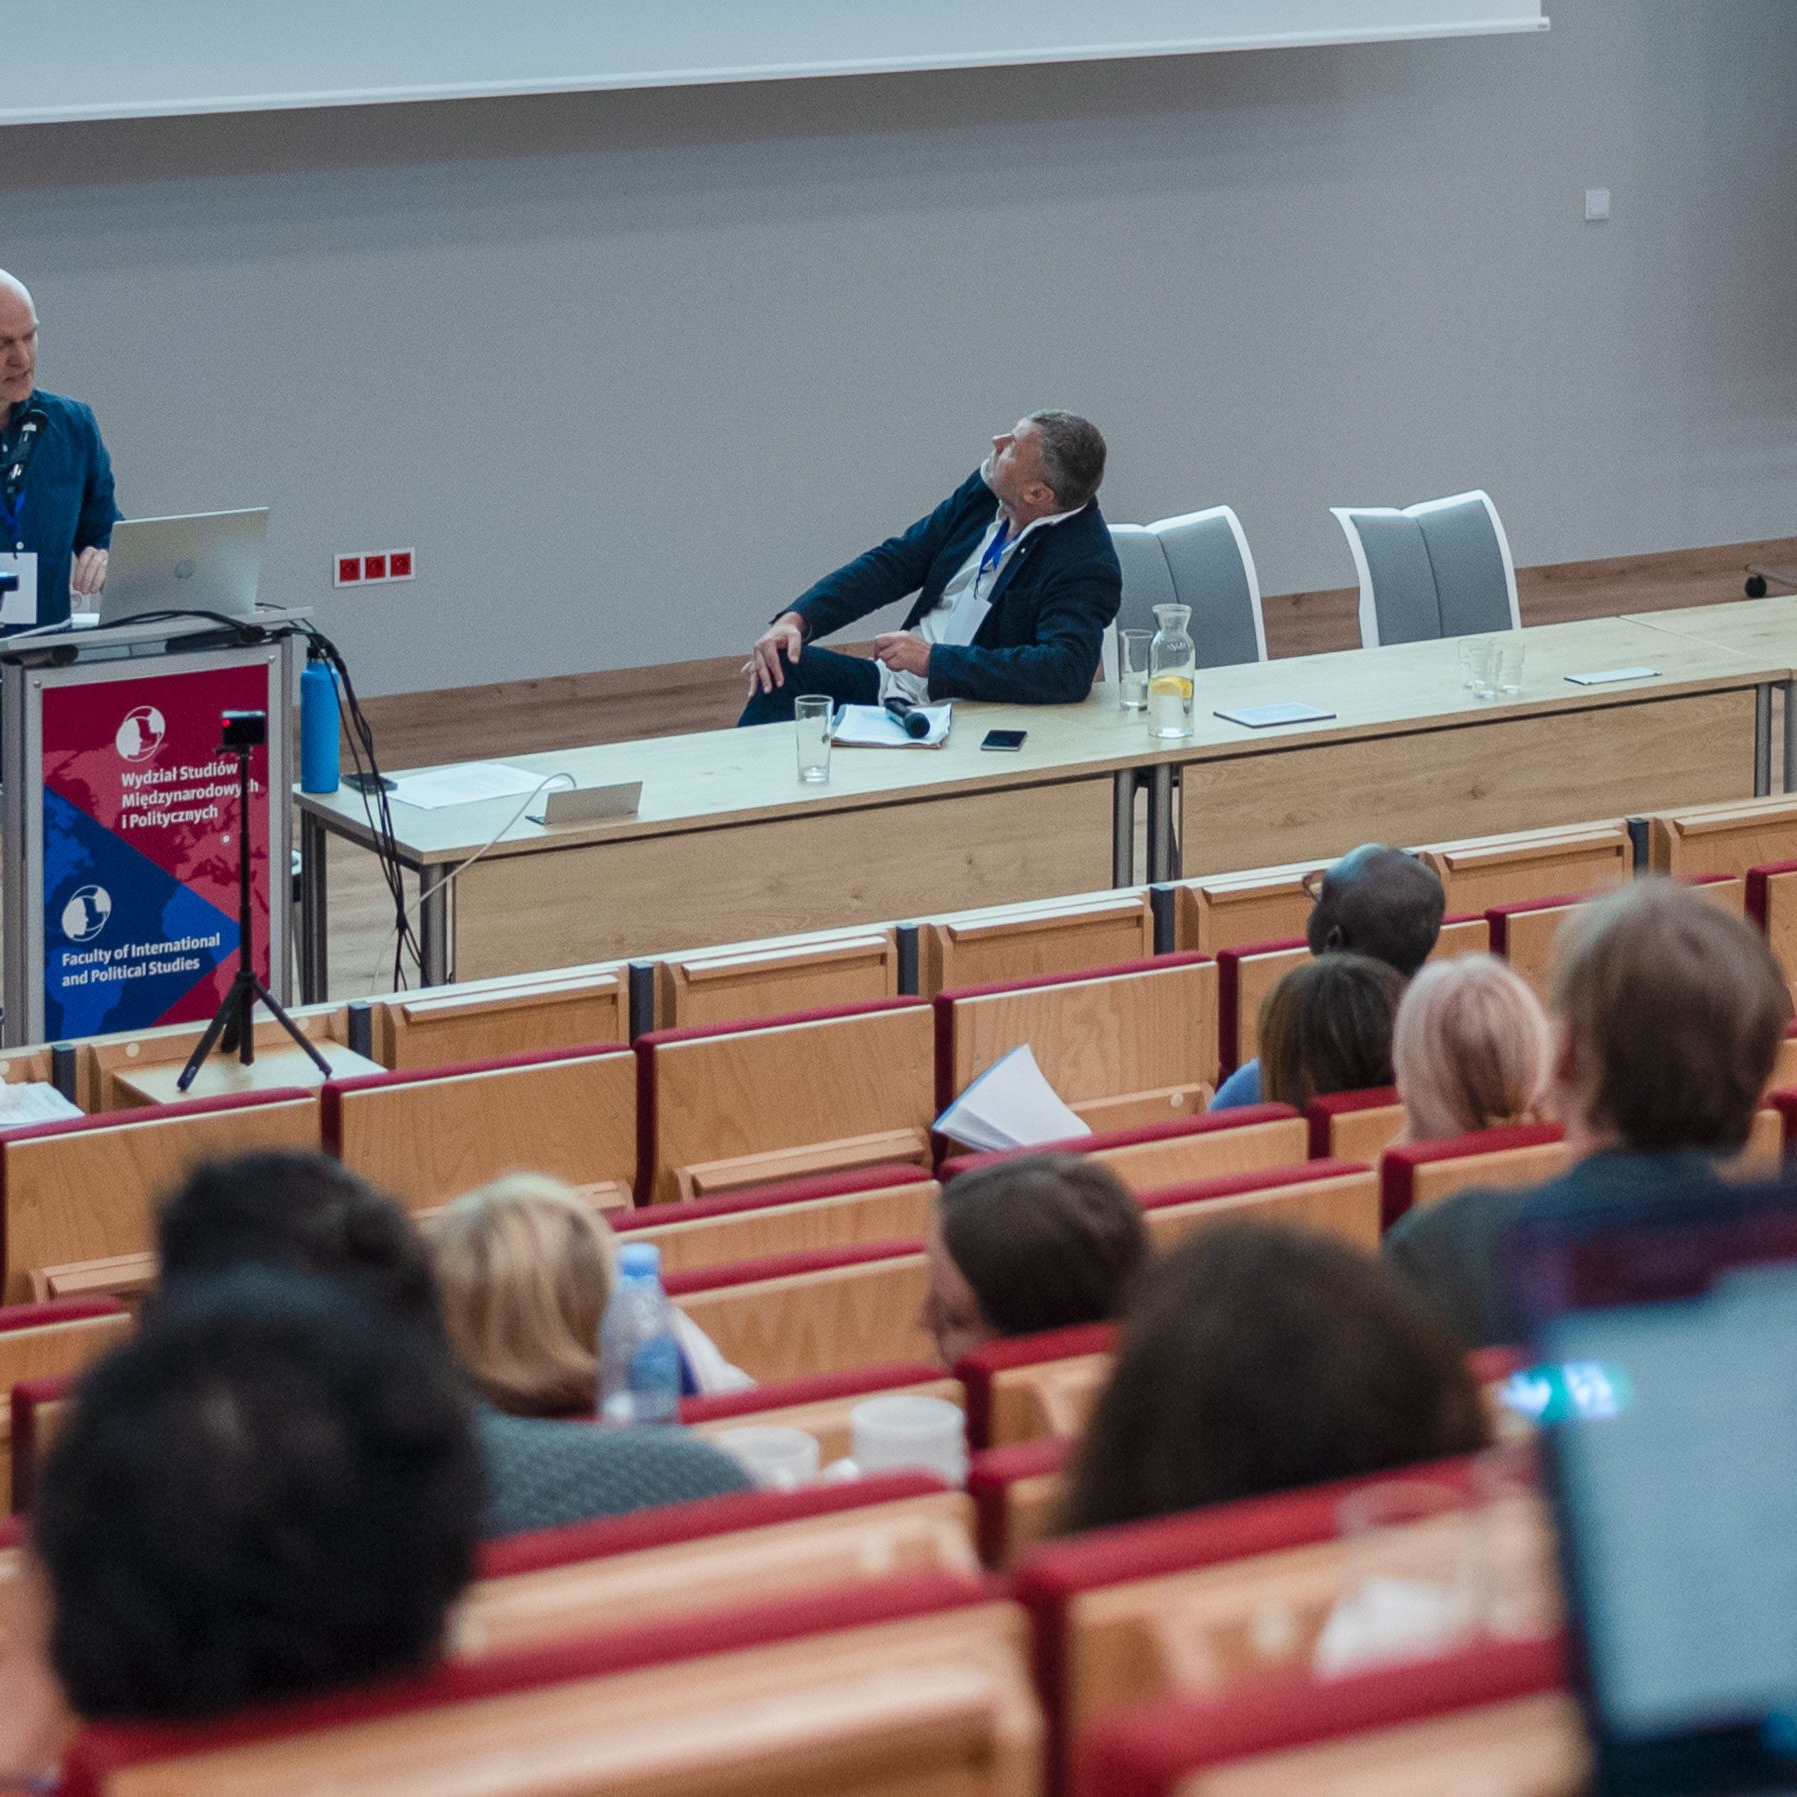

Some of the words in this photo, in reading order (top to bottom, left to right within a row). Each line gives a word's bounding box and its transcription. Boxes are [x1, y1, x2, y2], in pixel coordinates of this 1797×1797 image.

[121, 766, 178, 789] Wydział
[179, 761, 239, 780] Studiów
[121, 778, 260, 810] Międzynarodowyh
[121, 814, 127, 830] i
[129, 804, 219, 829] Politycznych
[62, 948, 112, 965] Faculty
[114, 943, 130, 960] of
[131, 932, 221, 958] International
[61, 970, 89, 987] and
[91, 962, 147, 983] Political
[148, 956, 201, 976] Studies
